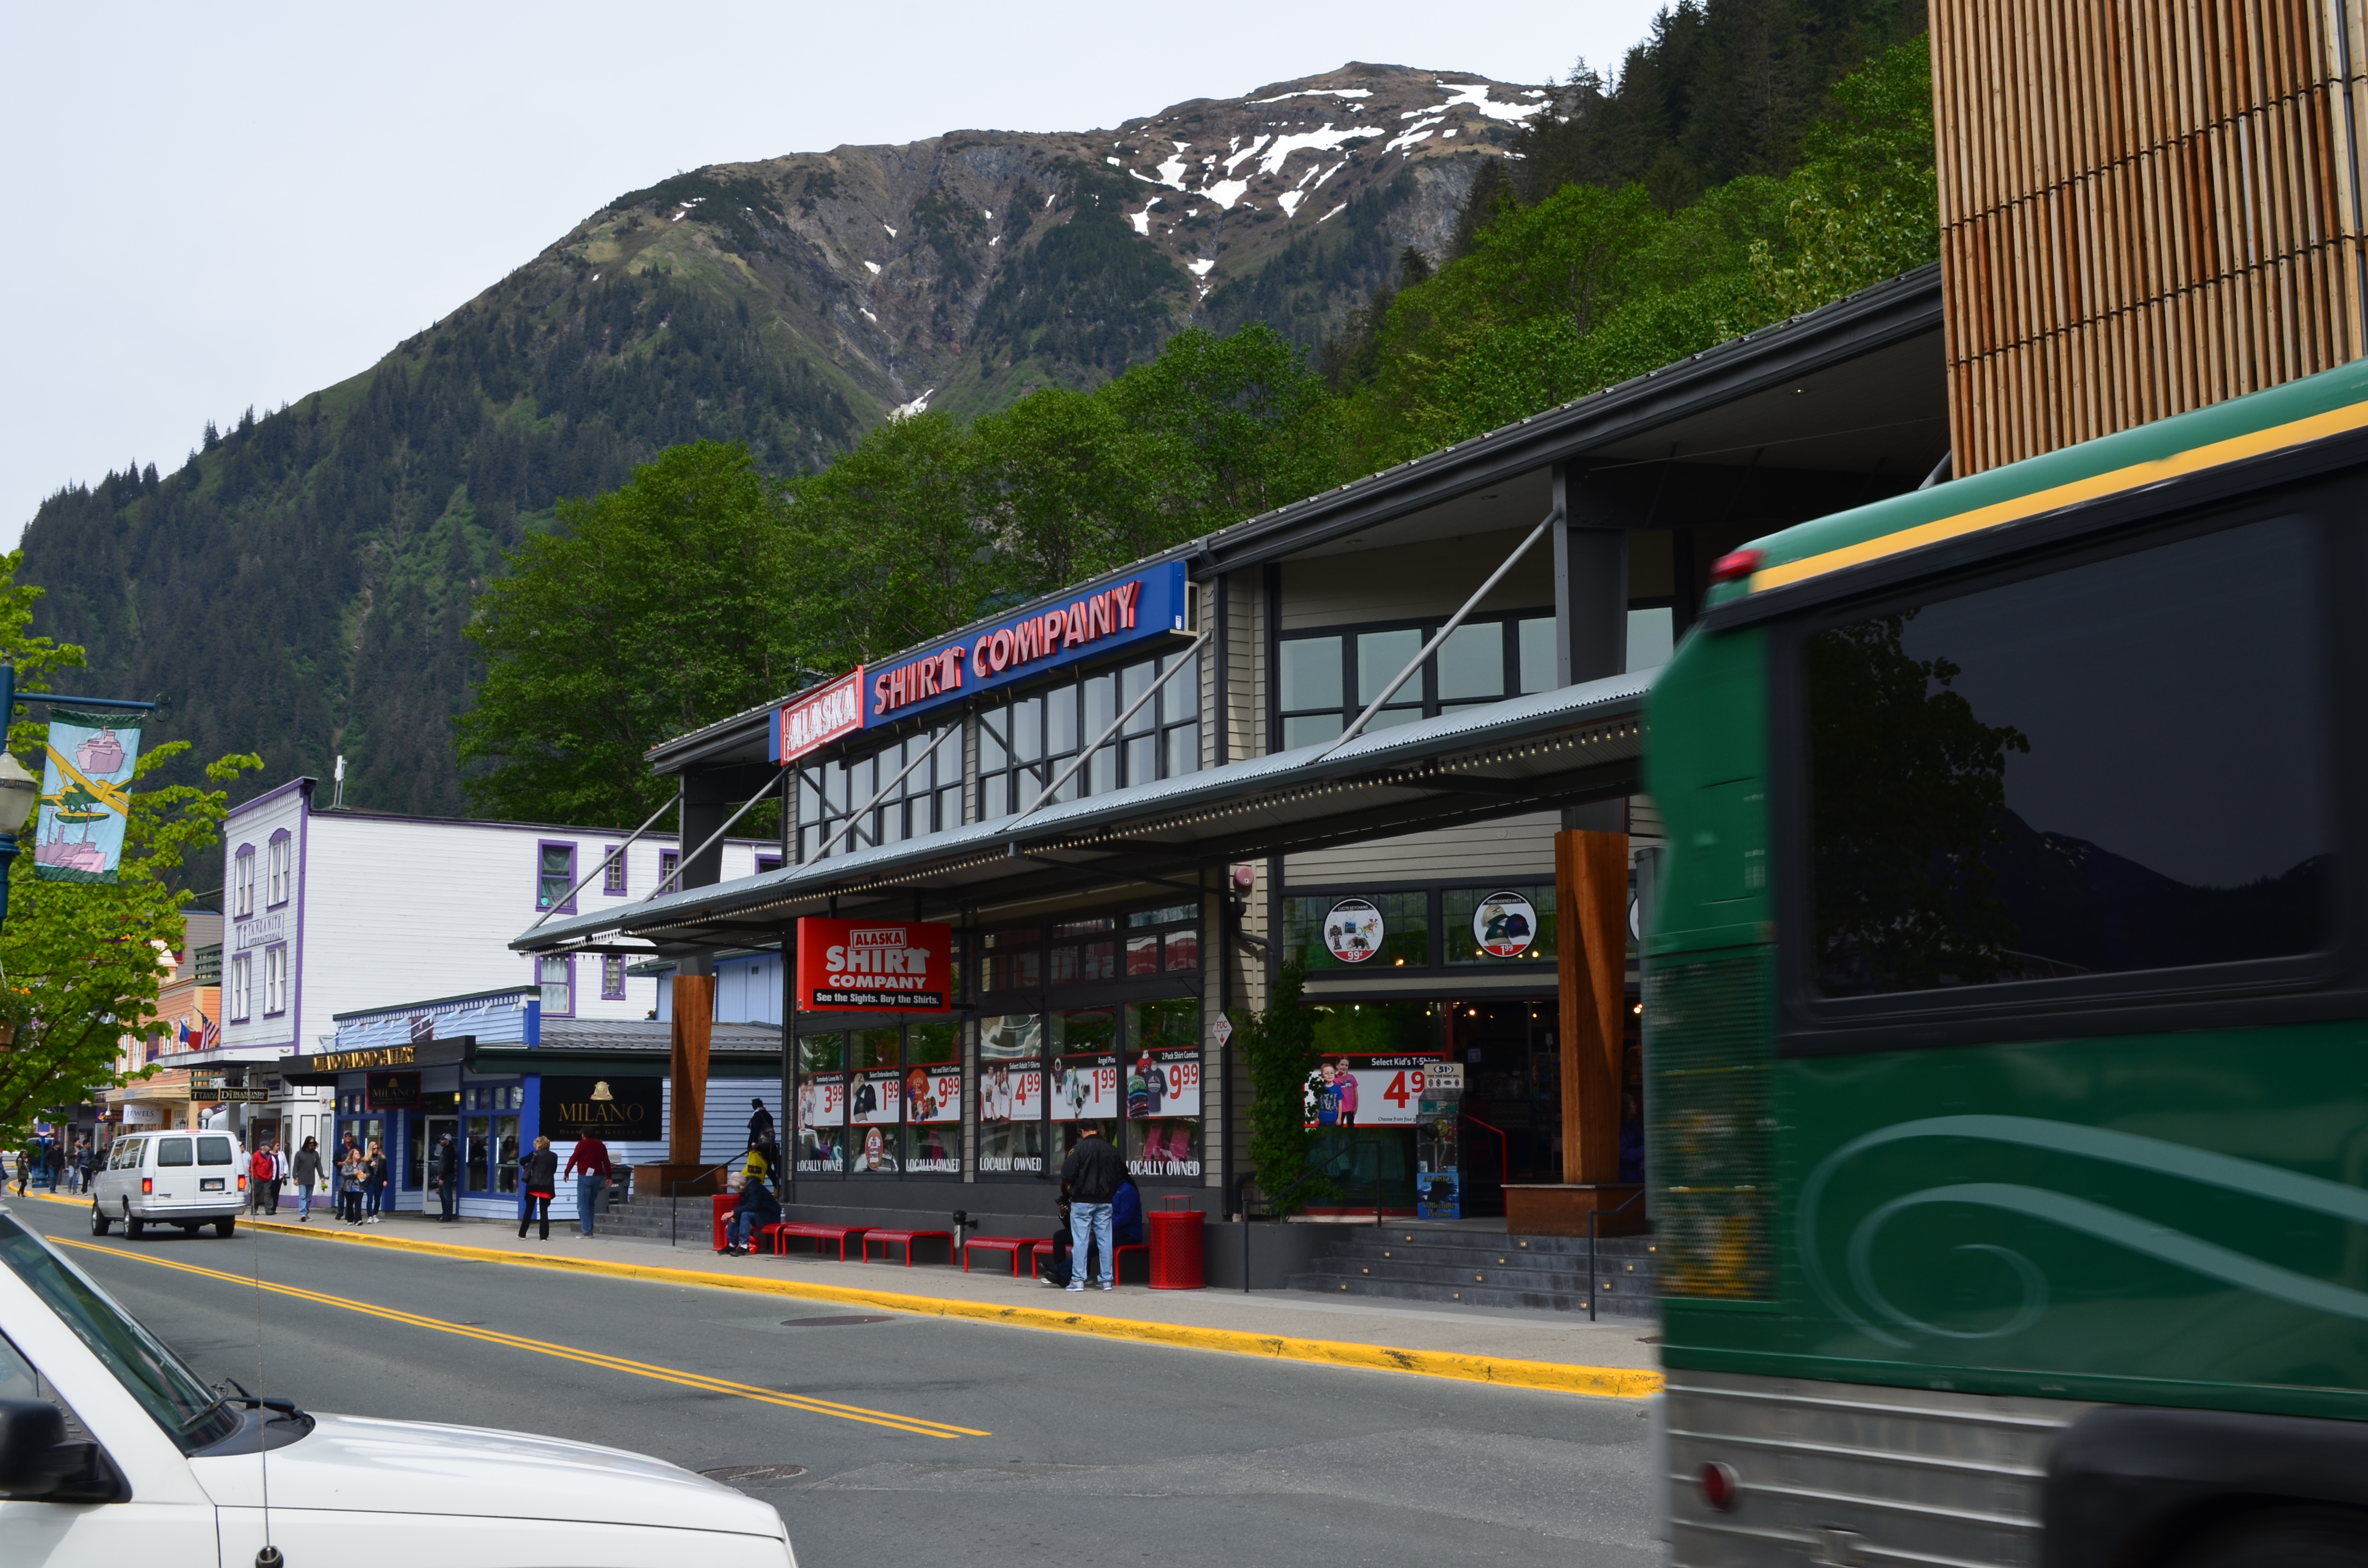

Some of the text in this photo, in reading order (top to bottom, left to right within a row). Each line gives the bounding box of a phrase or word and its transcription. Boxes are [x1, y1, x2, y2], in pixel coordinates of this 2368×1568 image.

[874, 581, 1141, 715] SHIRT COMPANY
[788, 682, 857, 750] ALASKA
[248, 915, 281, 936] TANZANITE
[248, 931, 280, 946] INTERNATIONAL
[855, 932, 902, 946] ALASKA
[826, 945, 930, 974] SHIRT
[829, 974, 926, 989] COMPANY
[816, 992, 939, 1005] See the Sights. Buy the Shirts.
[1217, 1020, 1227, 1029] FDC
[1098, 1056, 1108, 1066] Angel
[816, 1075, 828, 1083] Somebody
[373, 1088, 415, 1098] MILANO
[558, 1103, 644, 1122] MILANO
[797, 1160, 821, 1172] LOCALLY
[905, 1159, 960, 1172] LOCALLY OWNED
[979, 1157, 1042, 1171] LOCALLY OWNED
[1166, 1161, 1200, 1176] OWNED
